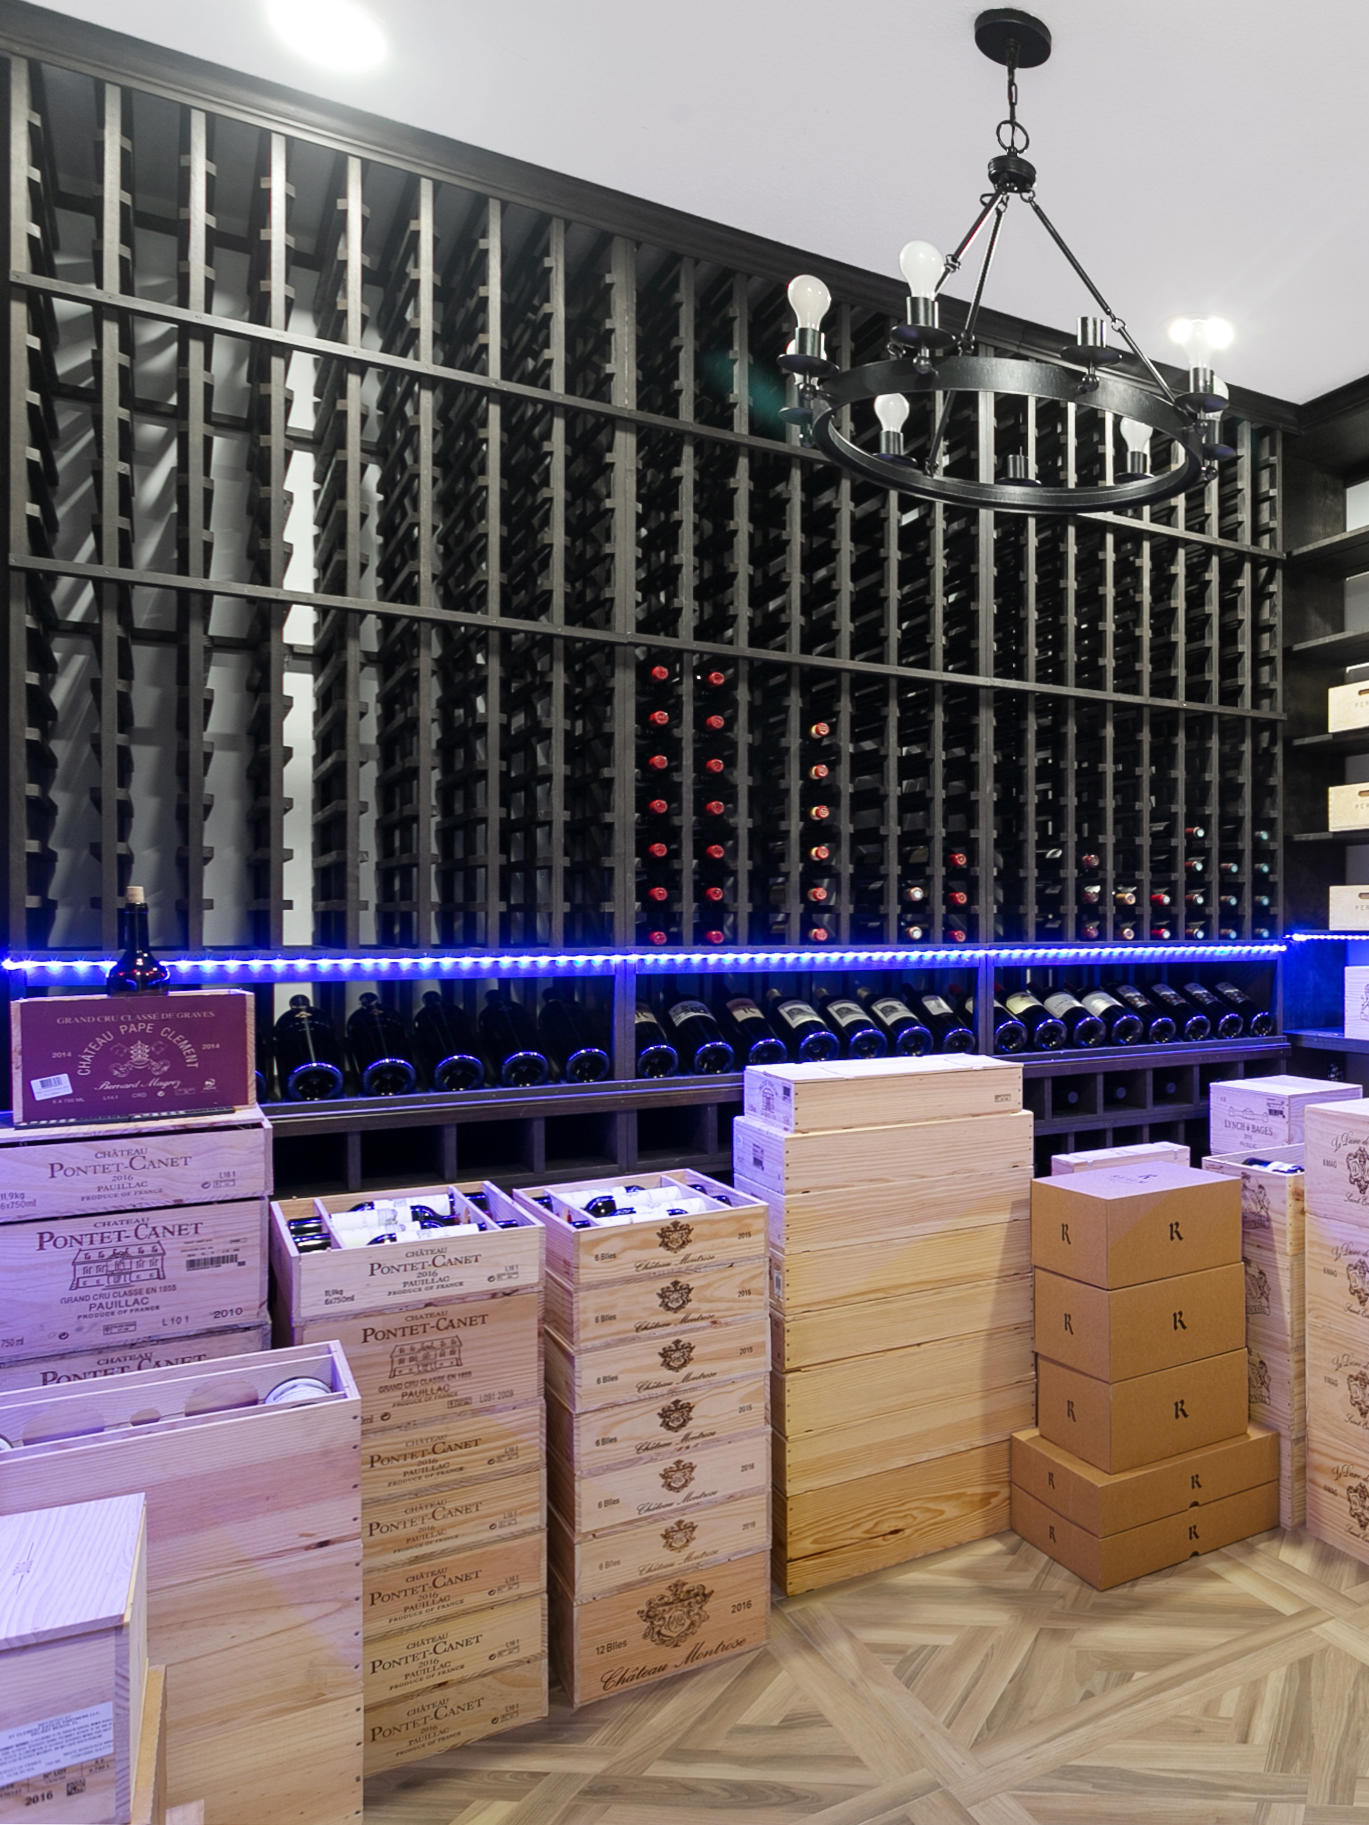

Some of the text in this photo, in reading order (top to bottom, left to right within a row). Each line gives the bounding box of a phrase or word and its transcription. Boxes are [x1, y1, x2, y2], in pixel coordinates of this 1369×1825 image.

[57, 1016, 95, 1024] GRAND
[97, 1014, 119, 1022] CRU
[176, 1010, 216, 1019] GRAVES
[119, 1022, 155, 1035] PAPE
[94, 1147, 148, 1160] CHÂTEAU
[48, 1155, 193, 1179] PONTET-CANET
[97, 1181, 149, 1192] PAUILLAC
[36, 1222, 203, 1251] PONTET-CANET
[1060, 1223, 1072, 1245] R
[1168, 1221, 1184, 1242] R
[368, 1253, 482, 1277] PONTET-CANET
[416, 1270, 438, 1278] 2016
[402, 1276, 450, 1288] PAUILLAC
[93, 1292, 111, 1301] CRU
[145, 1287, 157, 1295] EN
[88, 1297, 150, 1312] PAUILLAC
[213, 1307, 243, 1320] 2010
[361, 1313, 489, 1343] PONTET-CANET
[1063, 1313, 1074, 1335] R
[1172, 1310, 1188, 1331] R
[401, 1385, 450, 1399] PAUILLAC
[1066, 1400, 1077, 1423] R
[1174, 1399, 1189, 1420] R
[369, 1437, 482, 1469] PONTET-CANET
[1047, 1472, 1056, 1490] R
[1190, 1474, 1202, 1489] R
[368, 1501, 483, 1537] PONTET-CANET
[1048, 1525, 1057, 1544] R
[1188, 1524, 1201, 1540] R
[369, 1569, 482, 1607] PONTET-CANET
[731, 1600, 752, 1614] 2016
[369, 1634, 483, 1675] PONTET-CANET
[369, 1697, 484, 1743] PONTET-CANET
